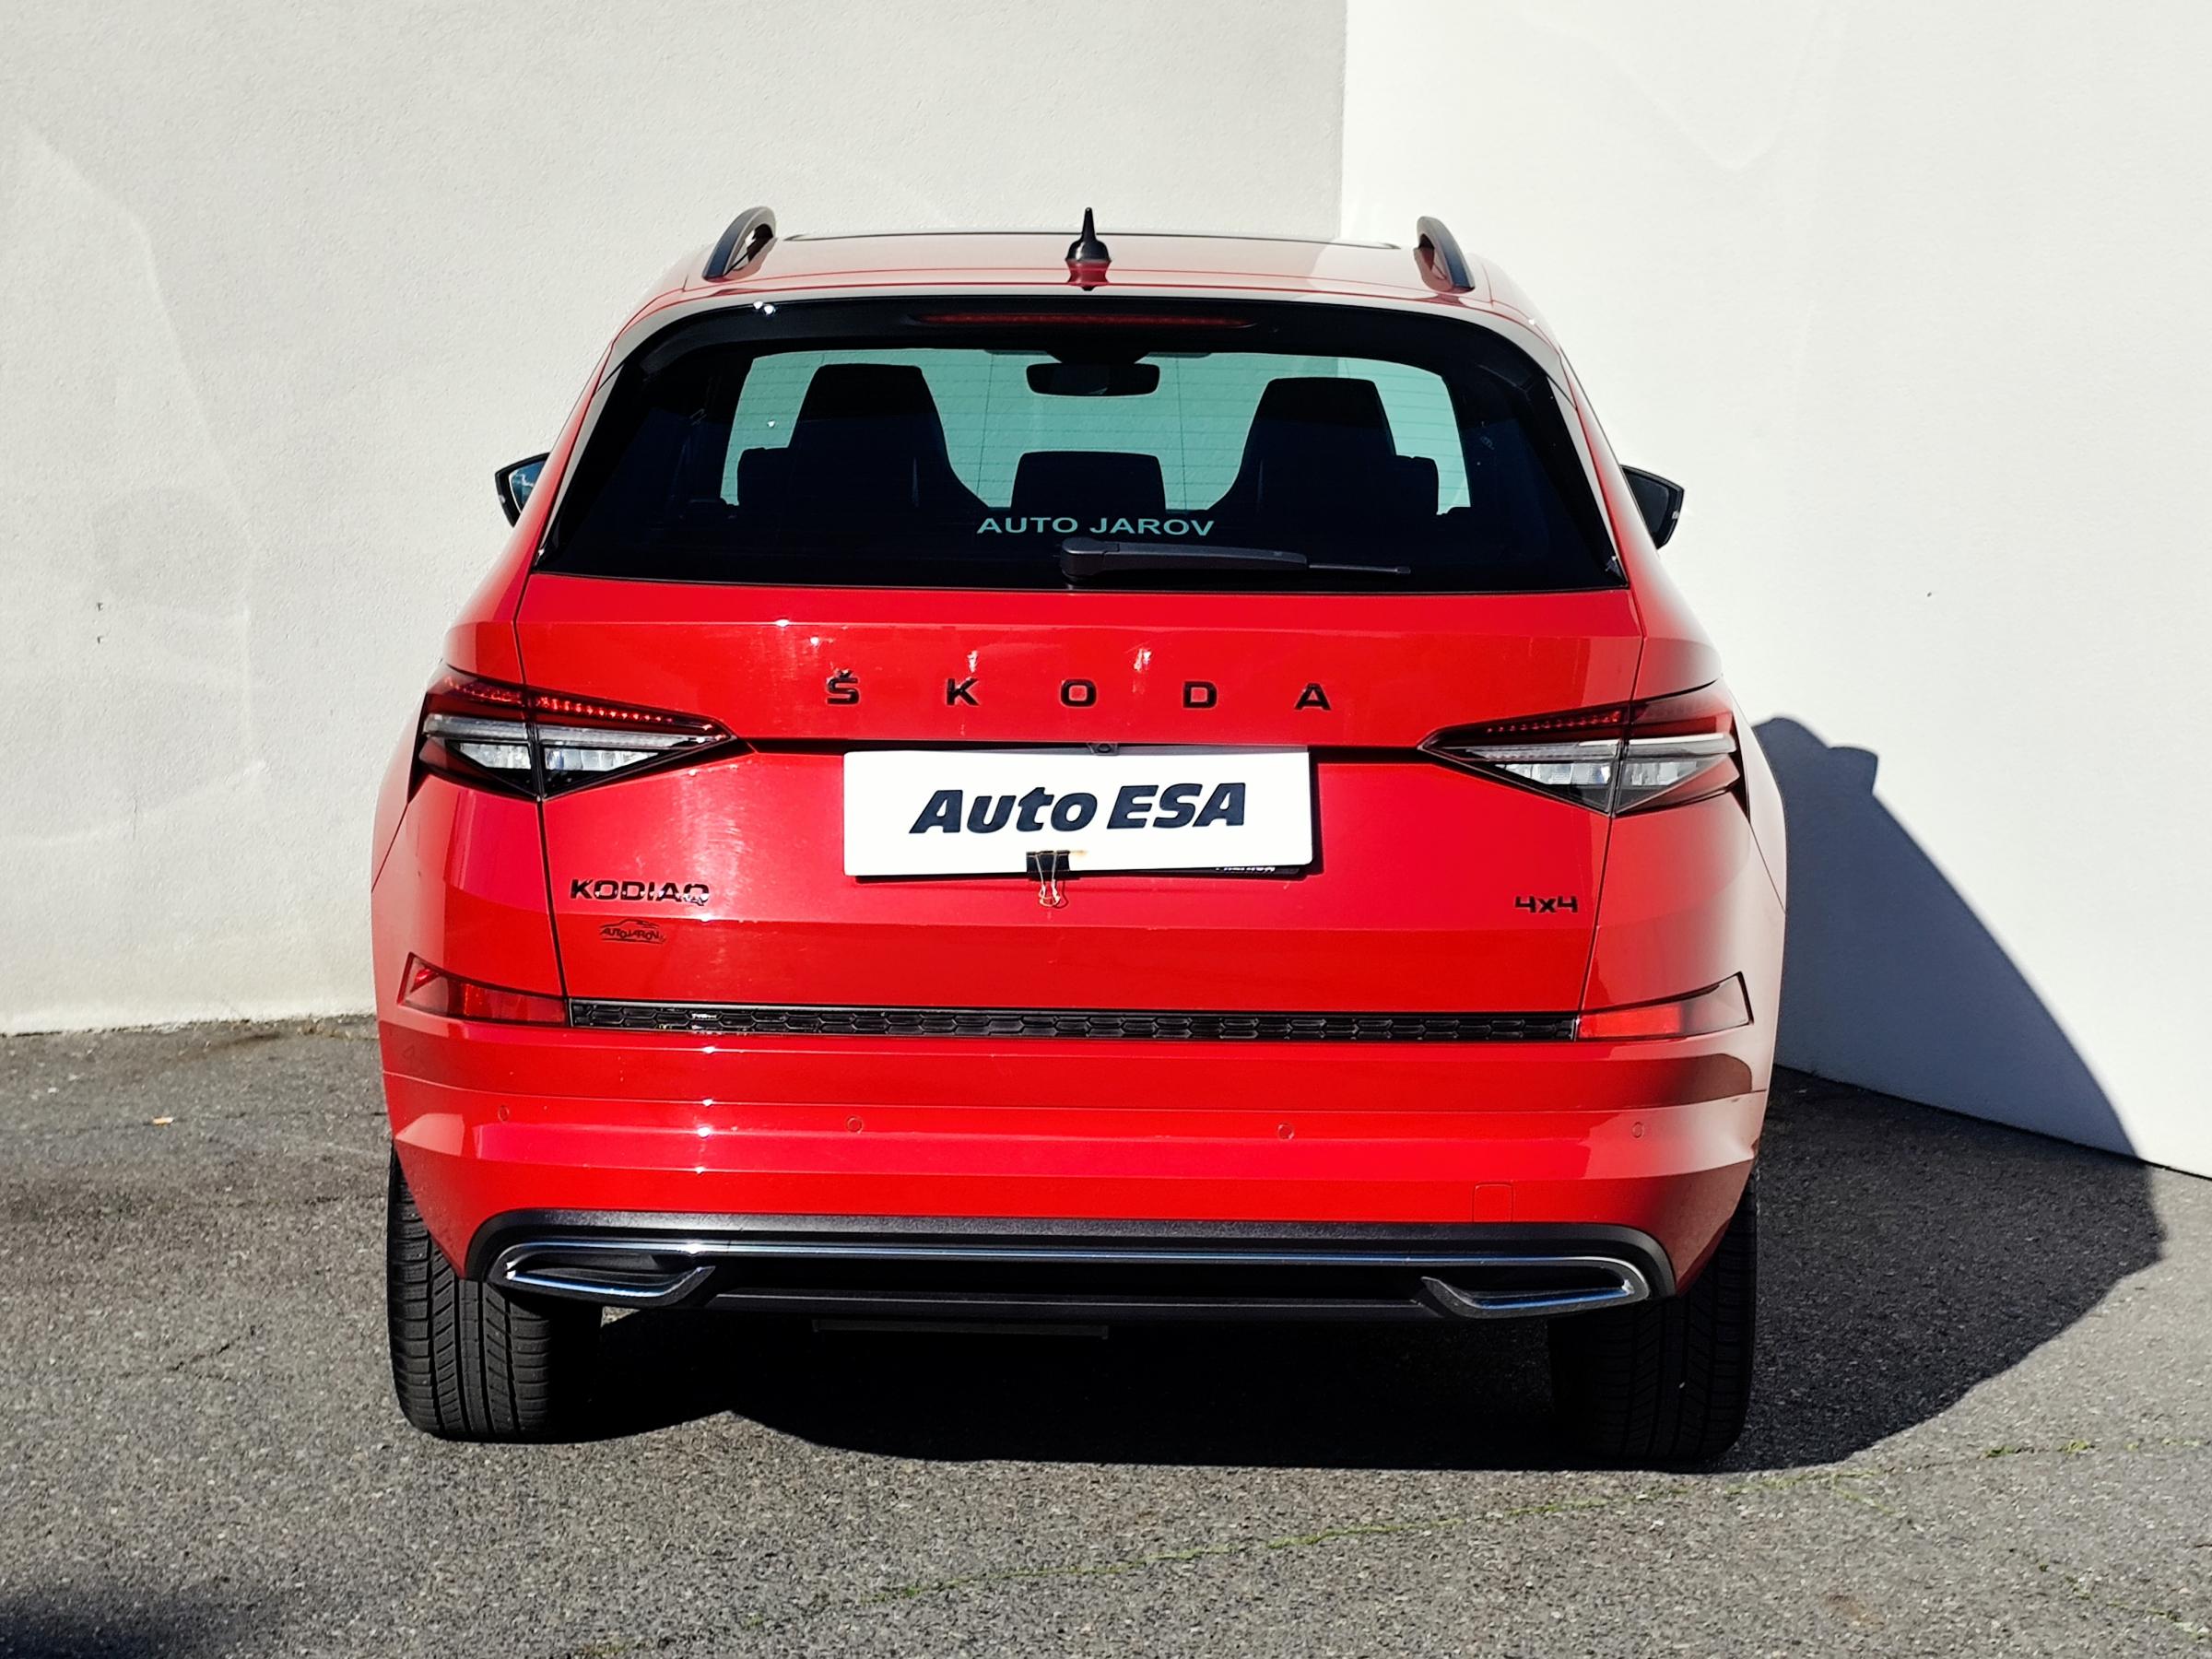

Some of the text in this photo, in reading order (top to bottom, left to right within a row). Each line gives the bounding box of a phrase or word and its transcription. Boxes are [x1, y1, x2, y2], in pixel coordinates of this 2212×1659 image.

[977, 517, 1215, 536] AUTO JAROV
[826, 669, 1332, 712] ŠKODA
[909, 782, 1247, 834] Auto ESA
[570, 878, 711, 906] KODIAQ
[1514, 895, 1578, 913] 4x4
